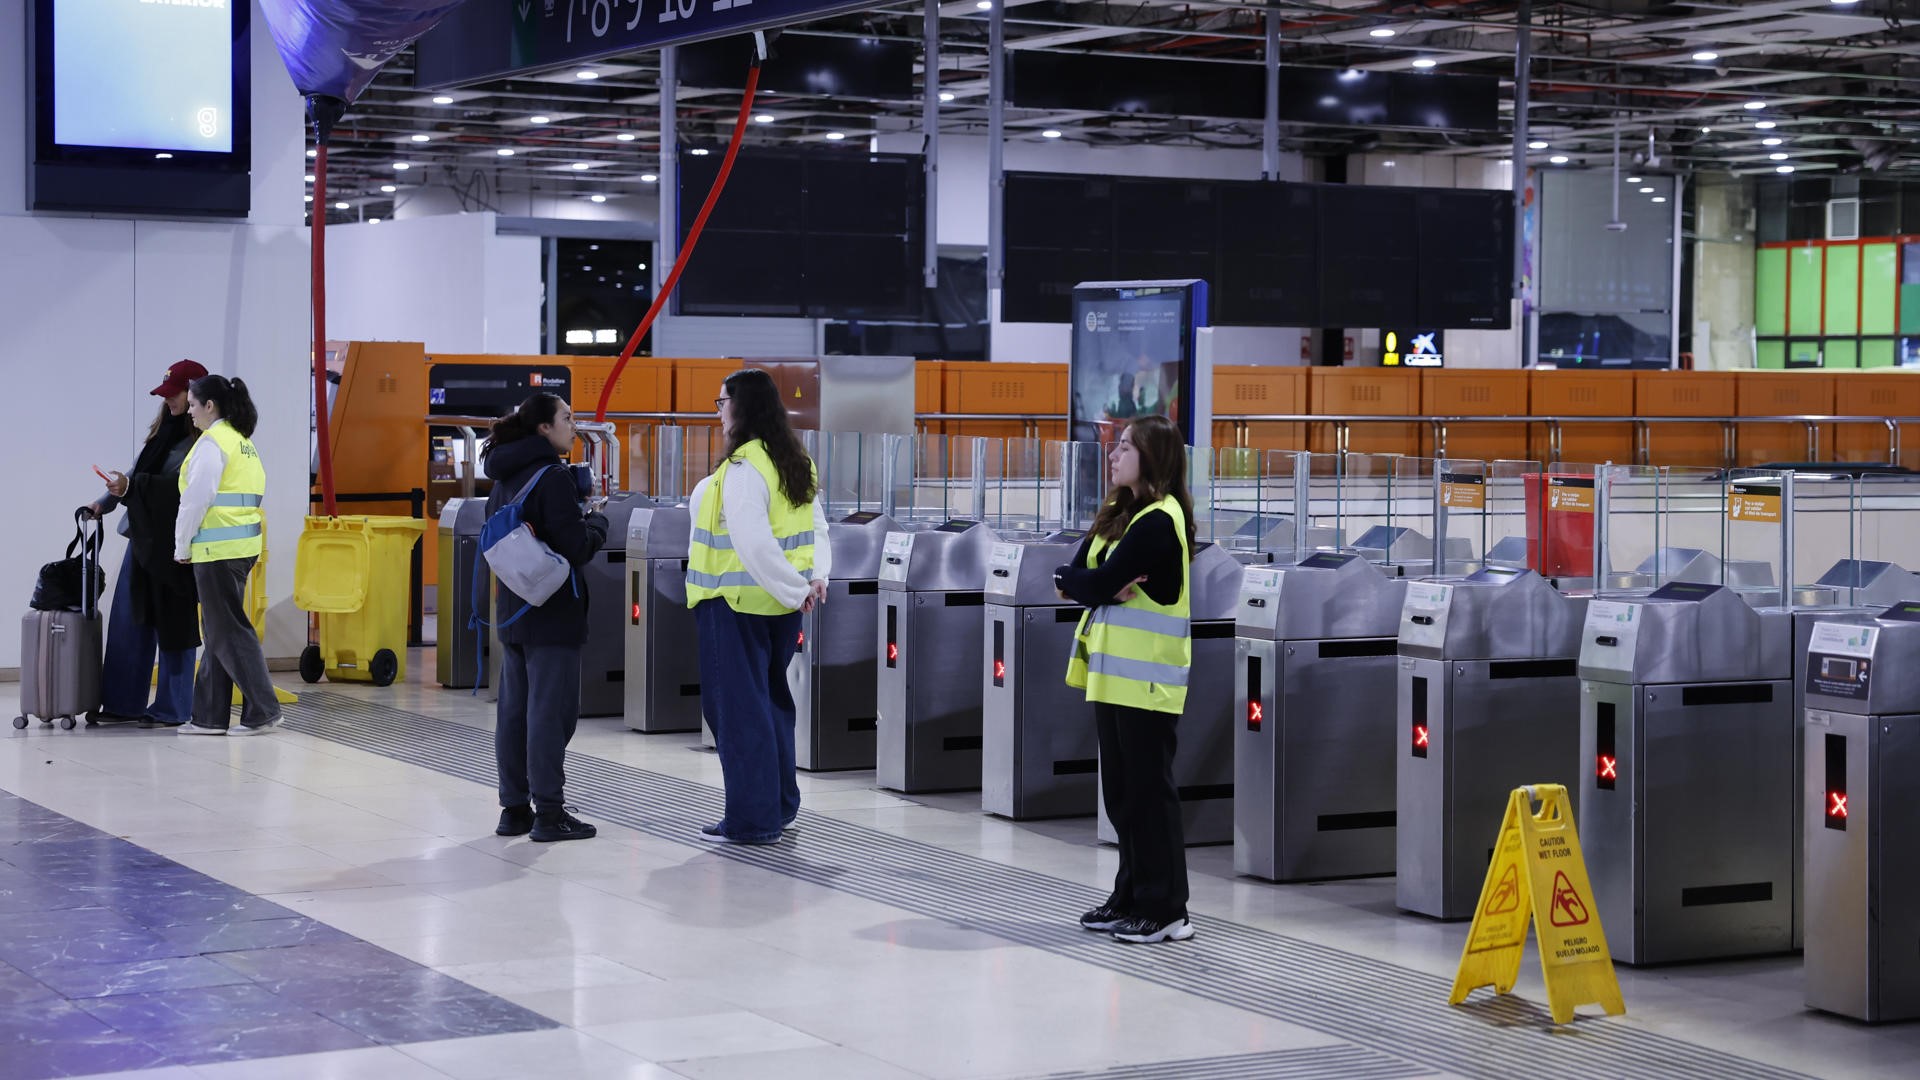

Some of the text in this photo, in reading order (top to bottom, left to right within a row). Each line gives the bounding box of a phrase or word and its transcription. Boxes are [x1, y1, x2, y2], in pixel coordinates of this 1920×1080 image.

[1539, 836, 1565, 847] CAUTION
[1538, 847, 1572, 859] WET FLOOR
[1563, 936, 1588, 947] PELIGRO
[1555, 944, 1600, 959] SUELO MOJADO
